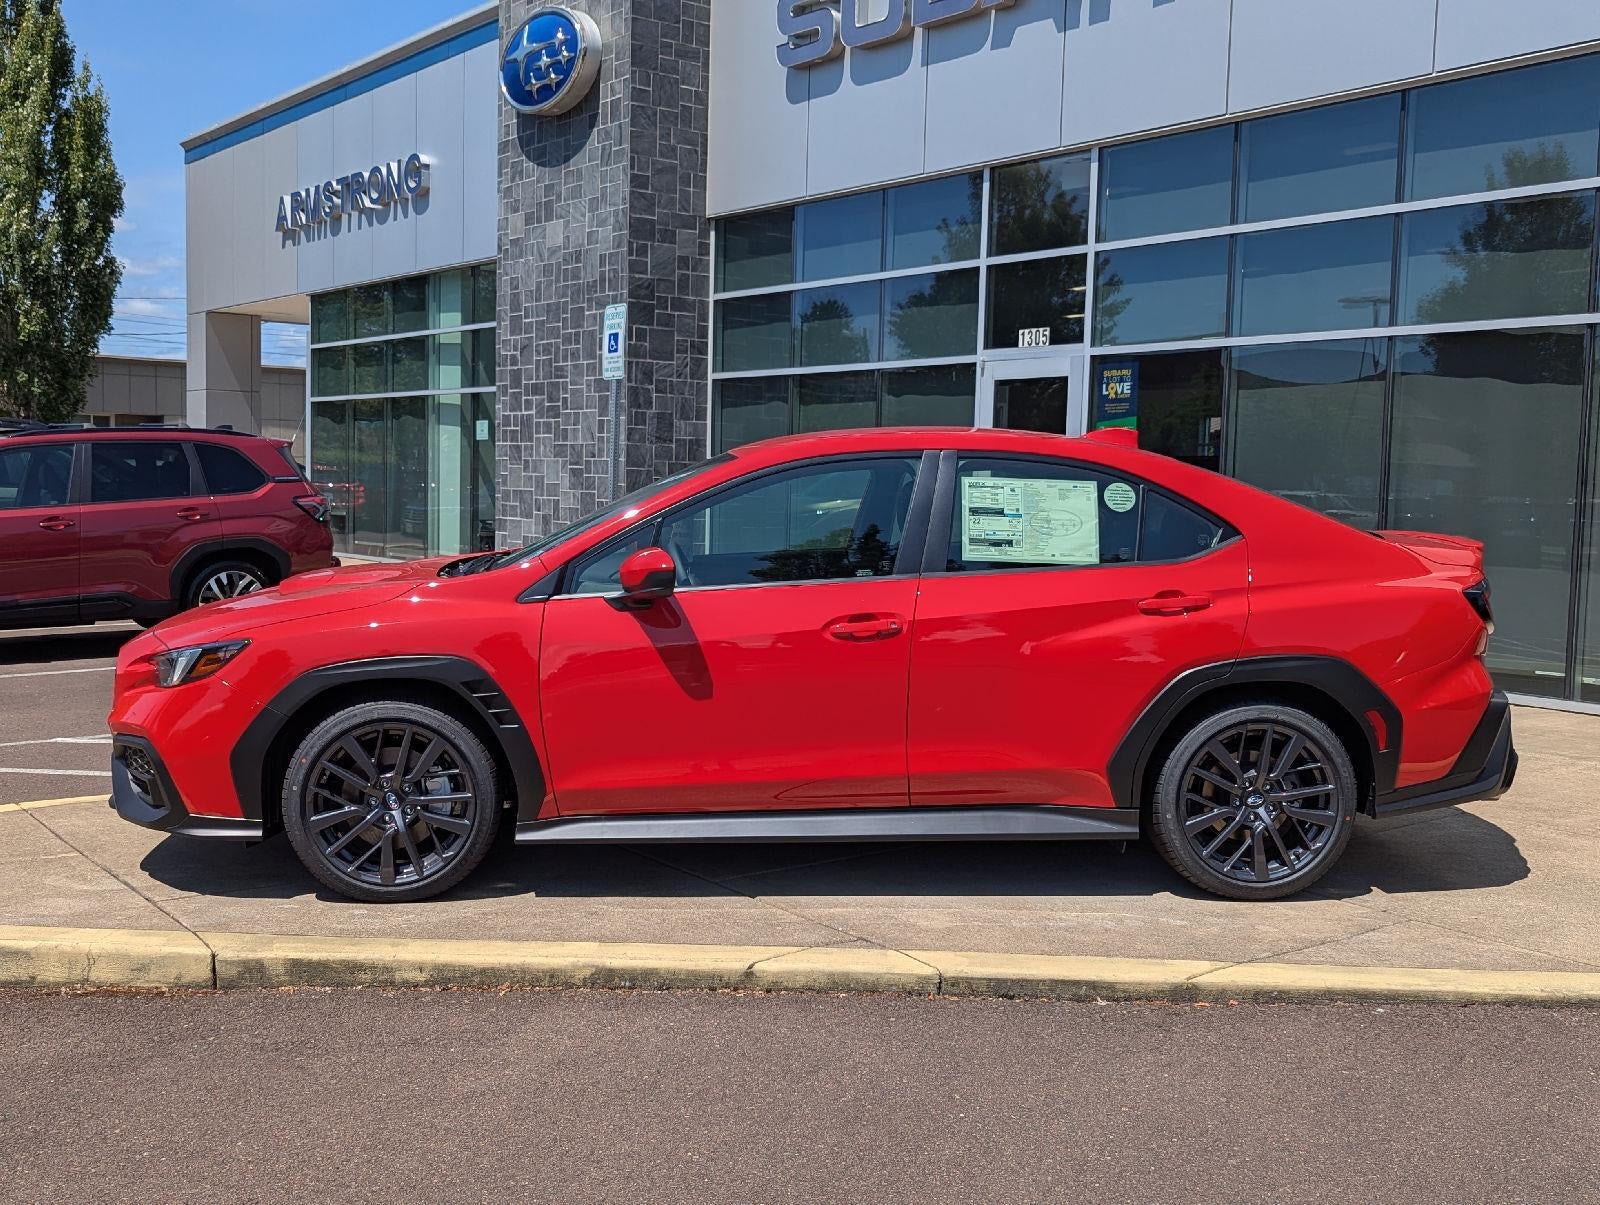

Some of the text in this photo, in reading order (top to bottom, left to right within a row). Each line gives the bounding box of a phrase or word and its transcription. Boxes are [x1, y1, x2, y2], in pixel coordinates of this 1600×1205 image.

[275, 153, 424, 232] ARMSTRONG
[1020, 329, 1048, 347] 1305
[1103, 369, 1132, 377] SUBARU
[1102, 382, 1131, 397] LOVE
[972, 517, 981, 525] 22
